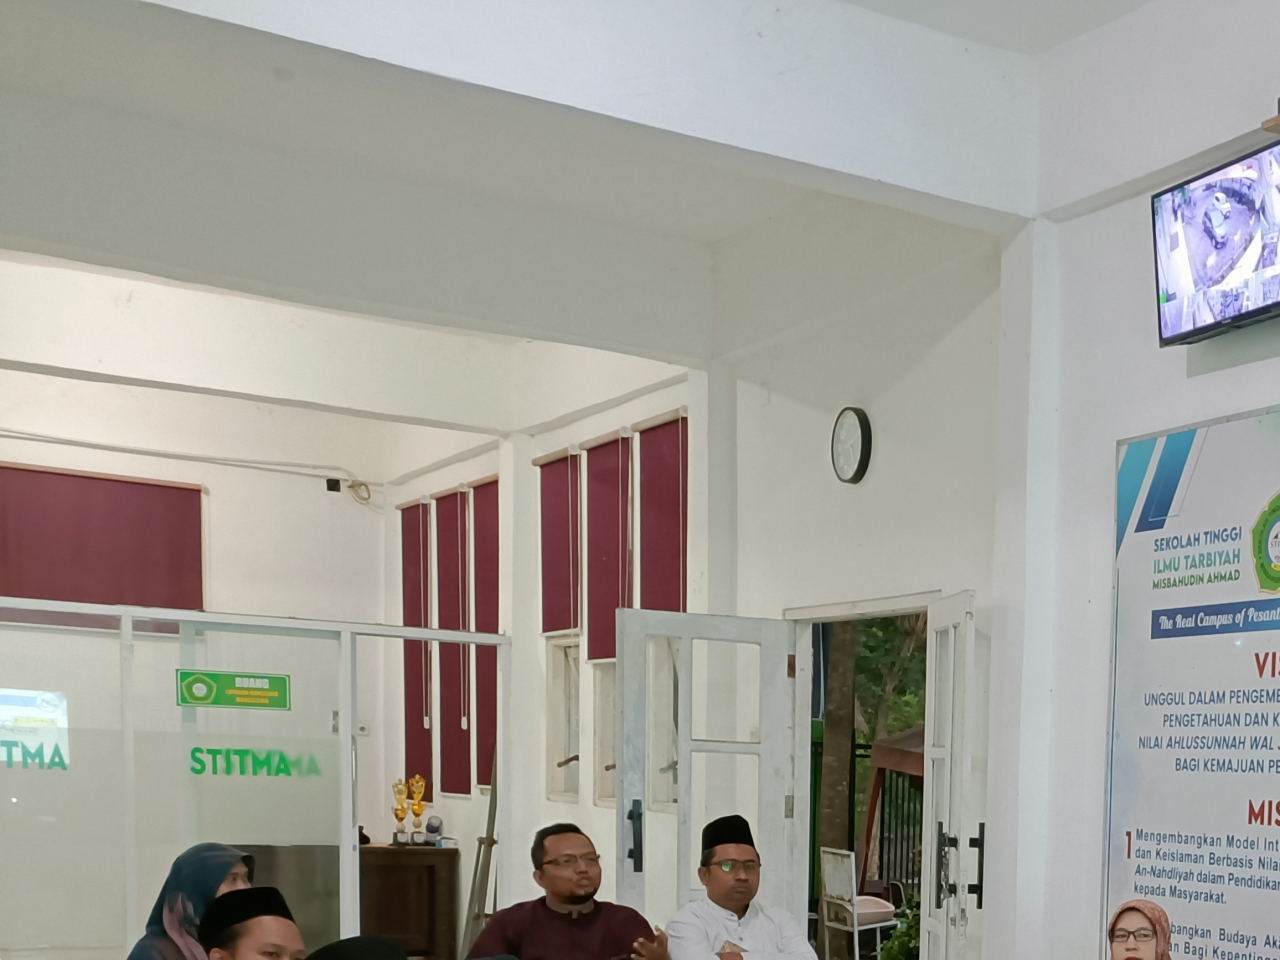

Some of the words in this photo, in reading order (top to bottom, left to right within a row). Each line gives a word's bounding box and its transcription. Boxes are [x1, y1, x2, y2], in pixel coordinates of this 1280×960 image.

[1154, 532, 1200, 552] SEKOLAH
[1204, 526, 1242, 545] TINGGI
[1153, 556, 1180, 574] ILMU
[1184, 548, 1240, 570] TARBIYAH
[1152, 573, 1204, 590] MISBAHUDIN
[1206, 569, 1240, 584] AHMAD
[1159, 615, 1173, 629] The
[1175, 613, 1195, 628] Real
[1197, 612, 1233, 629] Campus
[1235, 608, 1246, 627] of
[1144, 692, 1185, 706] UNGGUL
[1188, 690, 1226, 705] DALAM
[1163, 713, 1240, 728] PENGETAHUAN
[1244, 712, 1269, 727] DAN
[1138, 736, 1163, 749] NILAI
[1166, 736, 1246, 750] AHLUSSUNNAH
[1250, 736, 1274, 750] WAL
[0, 740, 67, 770] TMA
[190, 746, 292, 776] STITMA
[1175, 757, 1200, 772] BAGI
[1203, 758, 1264, 773] KEMAJUAN
[1125, 831, 1132, 859] 1
[1136, 828, 1222, 849] Mengembangkan
[1226, 835, 1260, 850] Model
[1135, 846, 1152, 860] dan
[1155, 848, 1204, 865] Keislaman
[1208, 852, 1253, 869] Berbasis
[1134, 864, 1194, 884] An-Nahdliyah
[1196, 870, 1225, 885] dalam
[1134, 881, 1166, 897] kepada
[1169, 885, 1227, 904] Masyarakat.
[1171, 922, 1212, 940] bangkan
[1219, 928, 1257, 948] Budaya
[1184, 941, 1208, 960] Bagi
